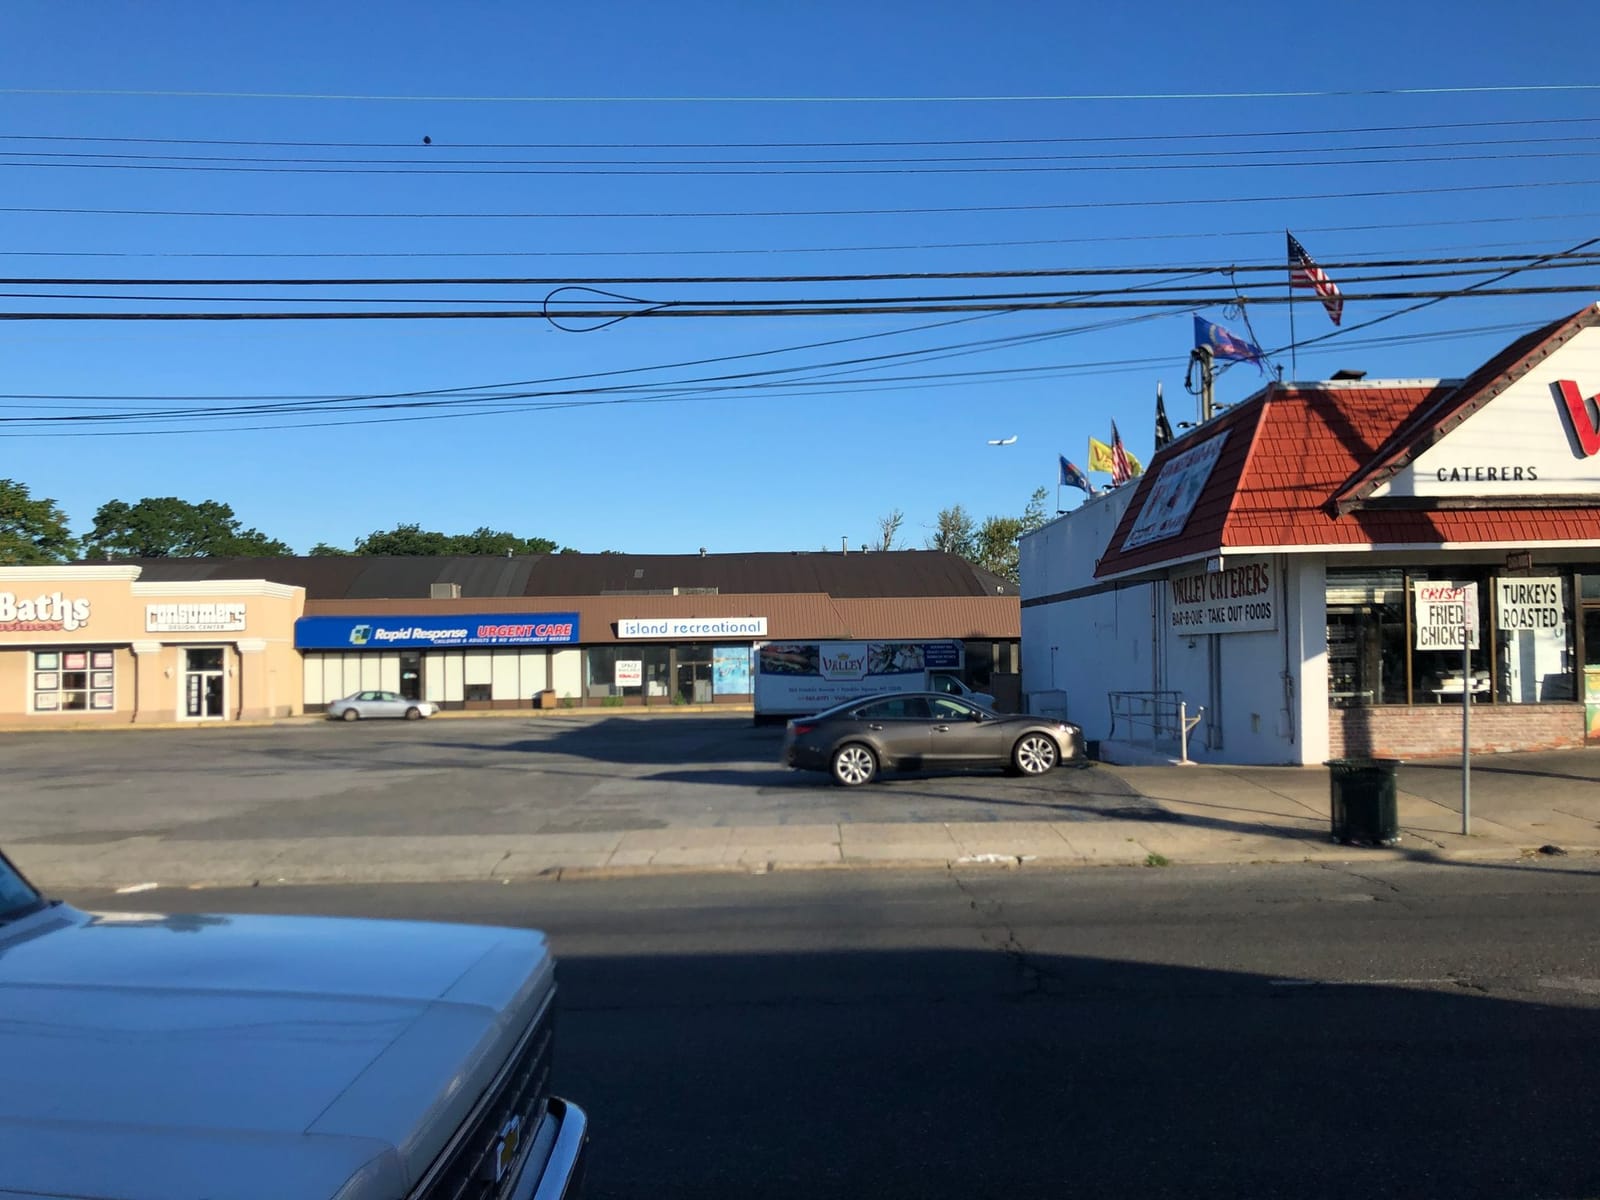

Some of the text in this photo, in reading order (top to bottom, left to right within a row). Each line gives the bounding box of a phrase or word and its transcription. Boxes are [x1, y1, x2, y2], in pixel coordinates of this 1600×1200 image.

[1437, 466, 1538, 482] CATERERS
[1172, 562, 1269, 606] VALLEY CATERERS
[1420, 587, 1468, 601] CRISP
[1503, 583, 1557, 604] TURKEYS
[0, 591, 91, 632] Baths
[1208, 607, 1225, 624] TAKE
[1227, 605, 1243, 622] OUT
[1245, 602, 1271, 621] FOODS
[1429, 604, 1464, 625] FRIED
[1503, 607, 1558, 628] ROASTED
[375, 628, 468, 642] Rapid Response
[477, 623, 573, 638] URGENT CARE
[625, 620, 761, 635] island recreational
[822, 655, 865, 671] VALLEY
